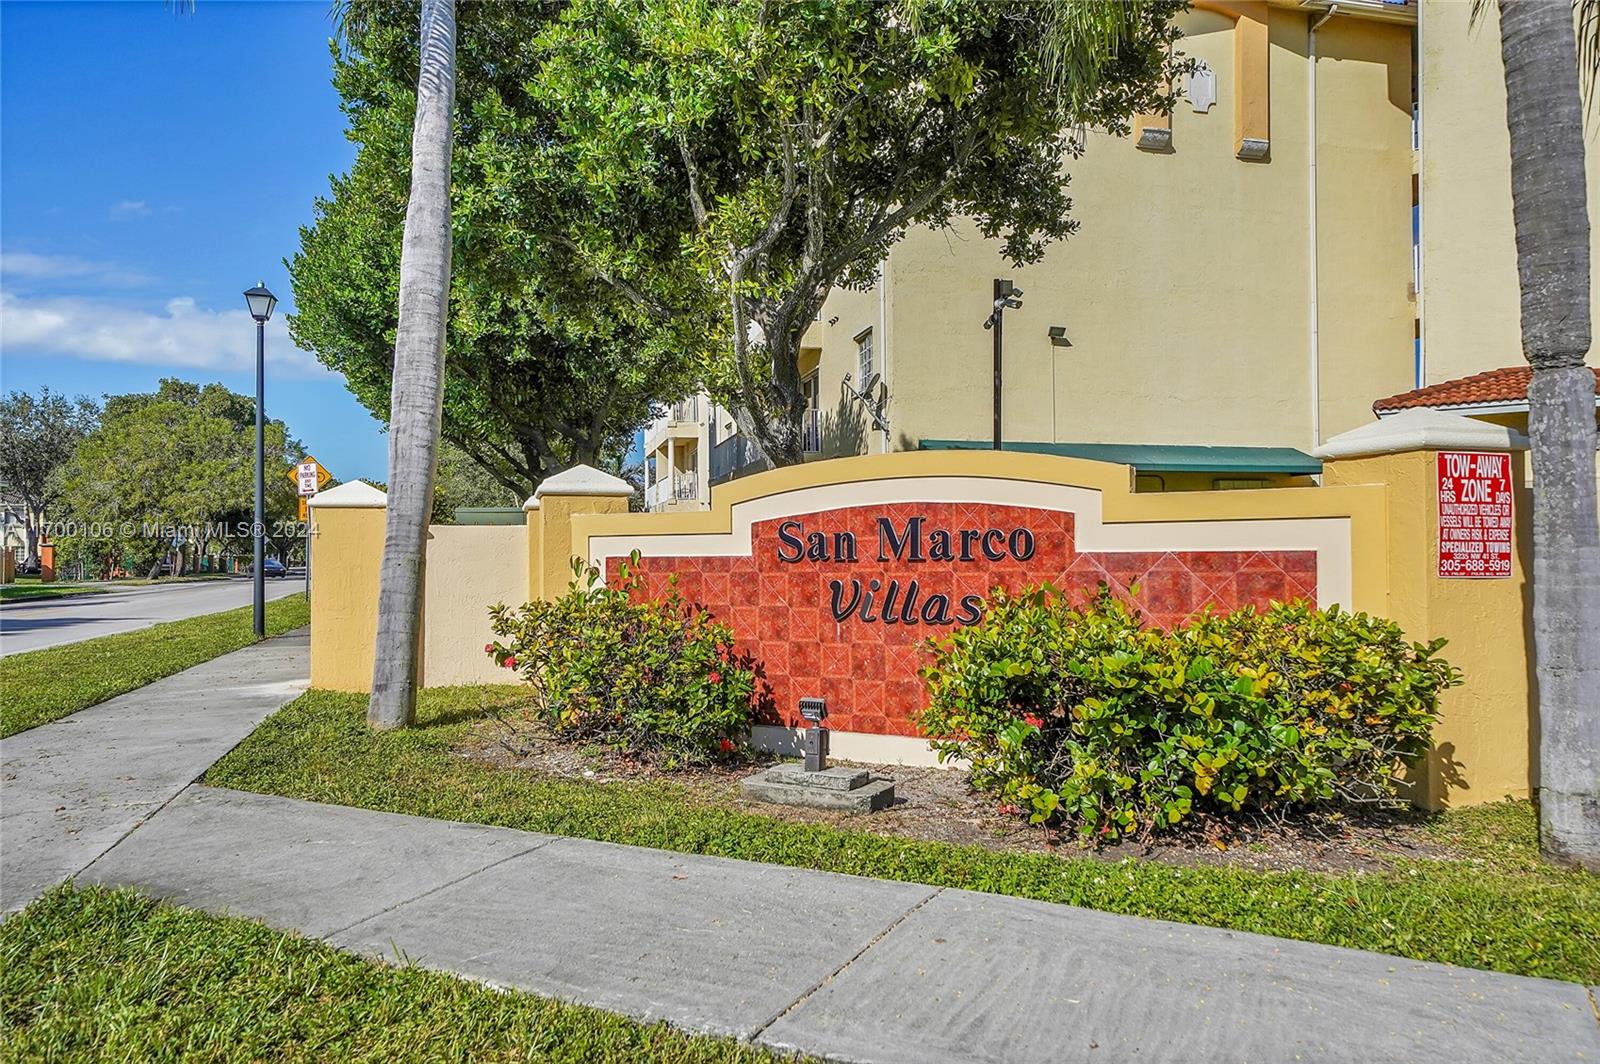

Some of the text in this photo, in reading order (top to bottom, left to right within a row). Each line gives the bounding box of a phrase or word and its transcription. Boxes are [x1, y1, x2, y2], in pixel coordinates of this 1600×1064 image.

[1444, 454, 1503, 478] TOW-AWAY
[1442, 477, 1453, 490] 24
[1499, 479, 1505, 491] 7
[1441, 490, 1456, 503] HRS
[1461, 479, 1492, 502] ZONE
[1496, 491, 1510, 504] DAYS
[1441, 503, 1478, 515] UNAUTHORIZED
[1479, 504, 1502, 516] VEHICLES
[1440, 516, 1462, 527] VESSELS
[1462, 516, 1474, 527] WILL
[1482, 516, 1499, 528] TOWED
[777, 515, 1036, 562] San Marco
[1441, 541, 1510, 553] SPECIALIZED TOWING
[1440, 559, 1510, 571] 305-688-5919
[829, 579, 982, 627] Villas
